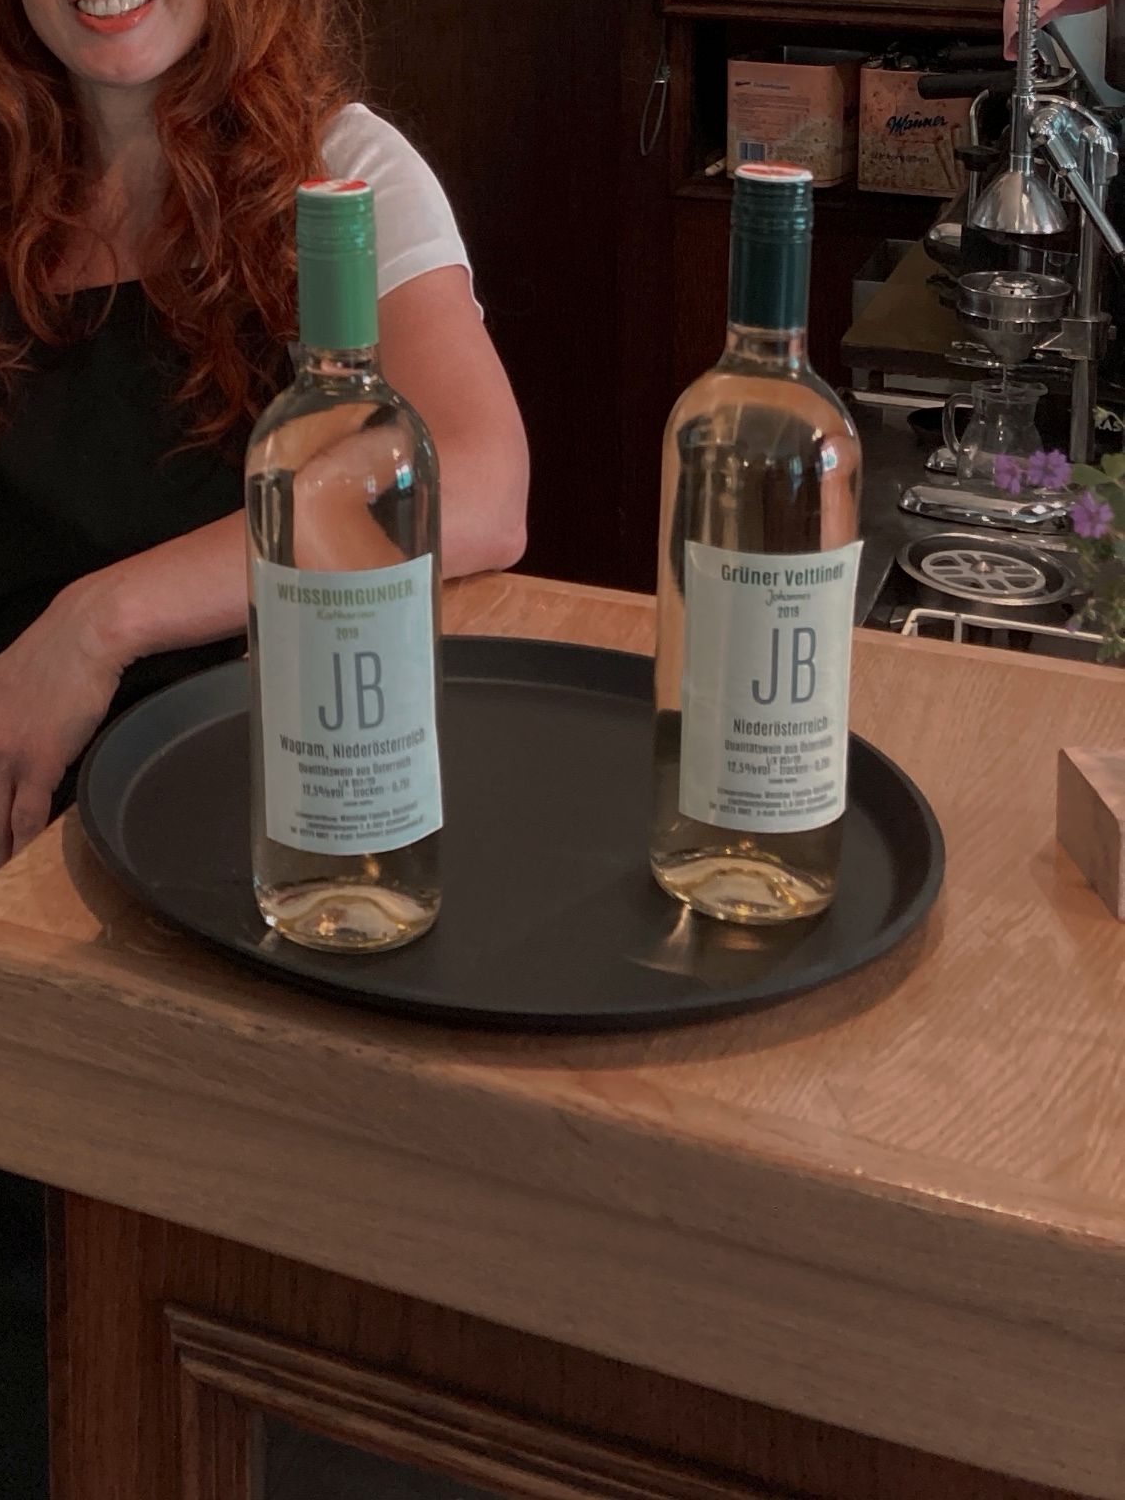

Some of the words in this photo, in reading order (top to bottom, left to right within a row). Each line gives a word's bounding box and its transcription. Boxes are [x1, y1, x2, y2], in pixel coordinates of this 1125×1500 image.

[885, 113, 949, 137] Manner
[721, 563, 780, 587] Grüner
[784, 560, 845, 587] Veltliner
[276, 578, 415, 607] WEISSBURGUNDER
[777, 605, 801, 618] 2019
[732, 715, 828, 738] Niederösterreich
[279, 734, 330, 761] Wagram,
[332, 727, 426, 760] Niederösterreich
